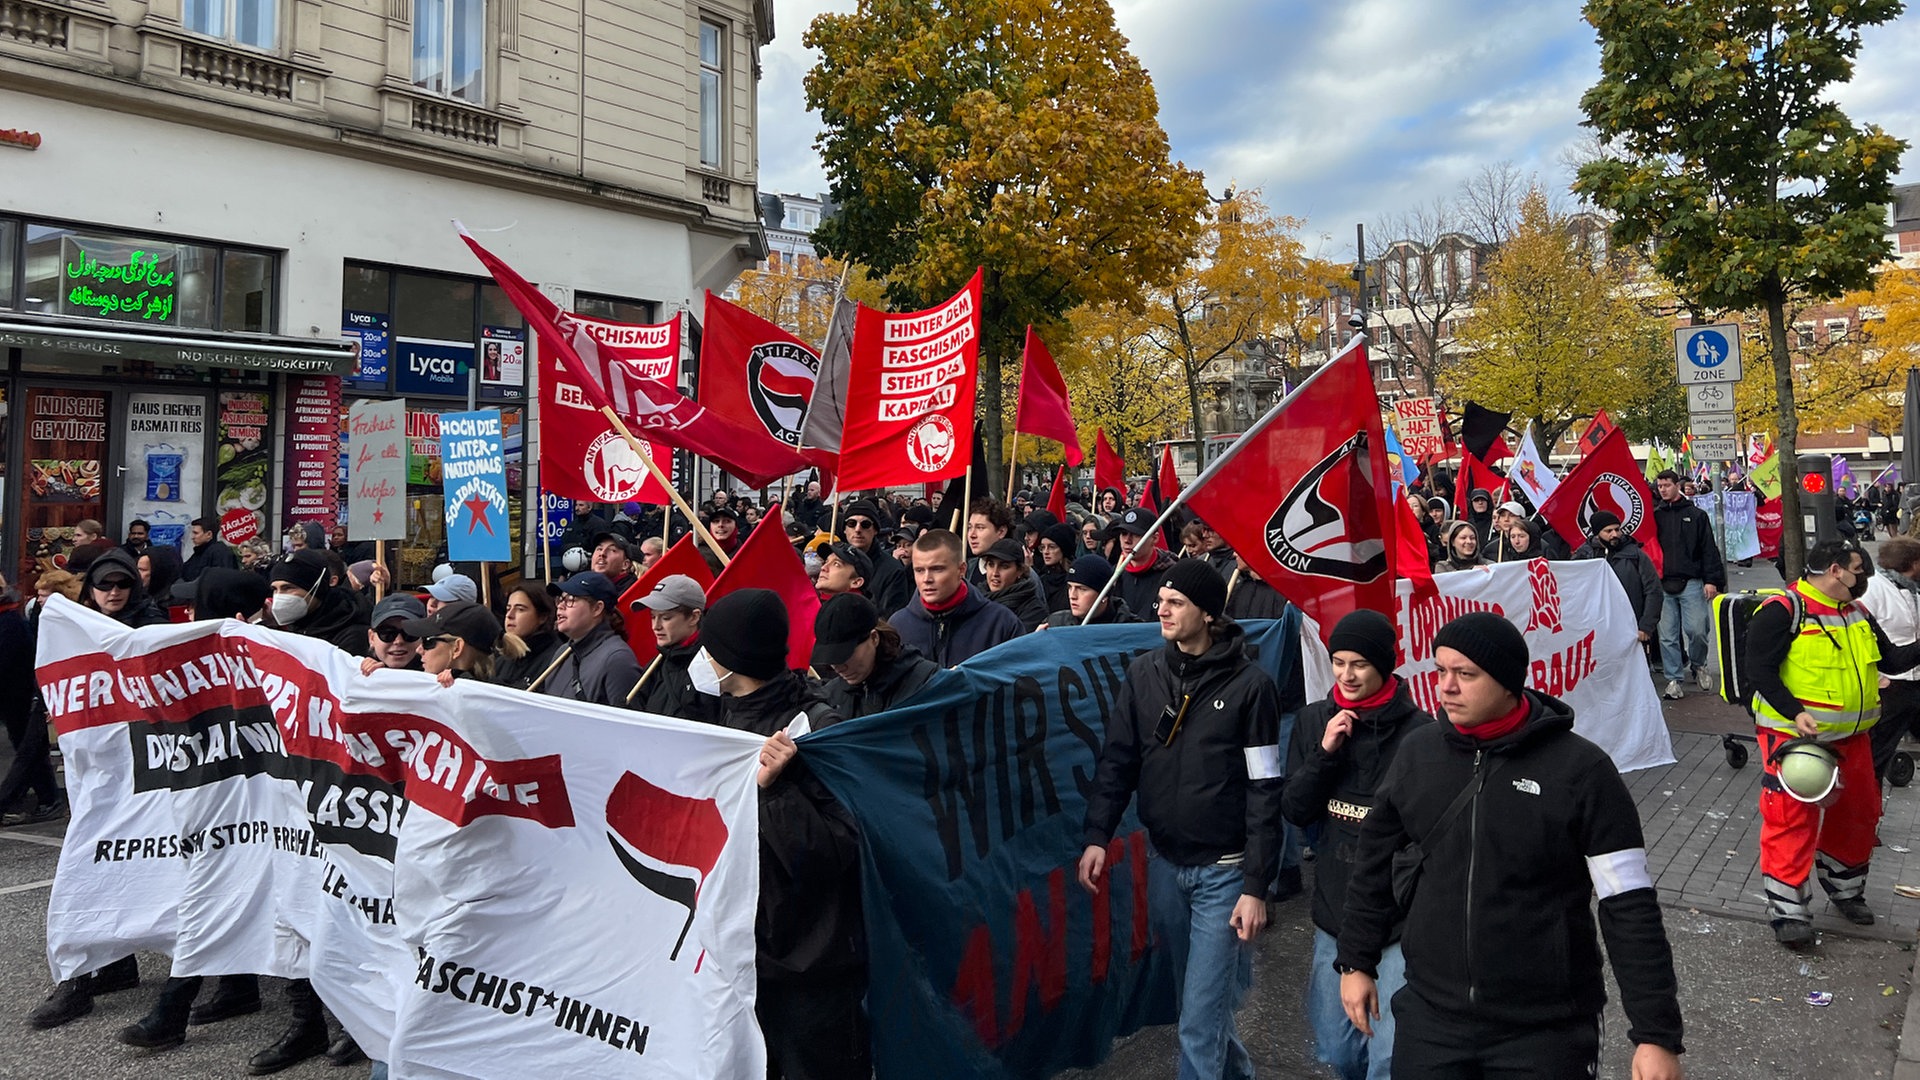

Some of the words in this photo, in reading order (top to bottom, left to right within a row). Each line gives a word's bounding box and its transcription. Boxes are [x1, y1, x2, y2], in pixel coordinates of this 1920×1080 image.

[350, 313, 371, 323] Lyca
[890, 315, 943, 338] HINTER
[946, 298, 969, 324] DEM
[177, 350, 242, 366] INDISCHE
[410, 352, 455, 376] Lyca
[503, 353, 515, 364] 20
[429, 373, 455, 383] Mobile
[887, 371, 933, 391] STEHT
[1694, 369, 1726, 381] ZONE
[503, 389, 519, 397] Lyca
[35, 394, 106, 418] INDISCHE
[133, 403, 160, 415] HAUS
[163, 404, 202, 417] EIGENER
[1395, 399, 1436, 418] KRISE
[1704, 401, 1719, 409] frei
[131, 419, 178, 432] BASMATI
[181, 421, 202, 434] REIS
[222, 412, 268, 426] ASIATISCHE
[1406, 419, 1434, 434] HAT
[1693, 418, 1732, 427] Lieferverkehr
[31, 419, 106, 442] GEWÜRZE
[440, 418, 476, 437] HOCH
[476, 419, 500, 436] DIE
[293, 434, 332, 442] LEBENSMITTEL
[414, 443, 437, 455] ALLER
[1403, 436, 1444, 456] SYSTEM
[1695, 442, 1734, 451] werktags
[594, 486, 637, 500] AKTION
[221, 512, 257, 532] TÄGLICH
[226, 522, 258, 541] FRISCH
[1269, 528, 1312, 571] AKTION
[41, 670, 115, 717] WER
[911, 676, 1062, 882] WIR
[210, 821, 268, 850] STOPP
